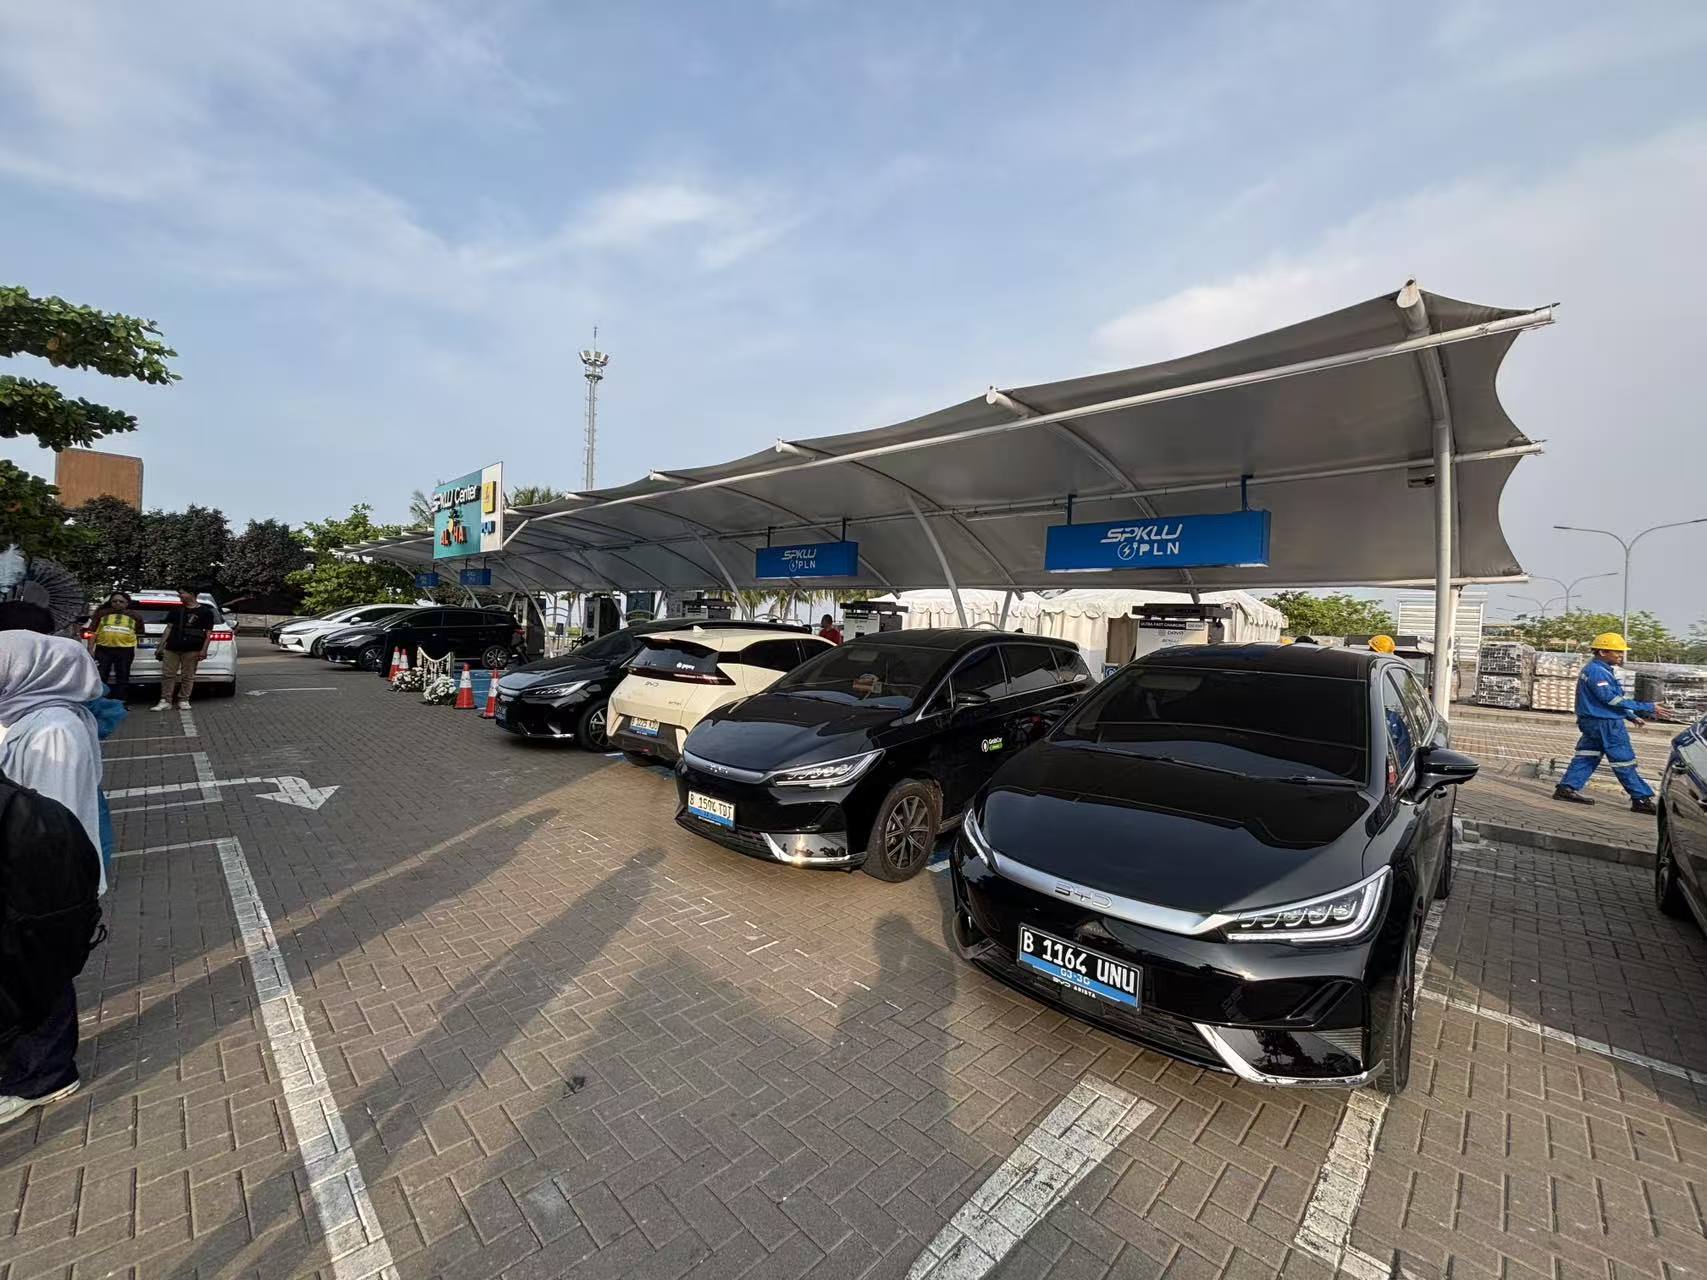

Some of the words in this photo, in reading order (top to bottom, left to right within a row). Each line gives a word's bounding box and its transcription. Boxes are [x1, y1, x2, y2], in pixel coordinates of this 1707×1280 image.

[454, 484, 477, 504] Center
[1100, 523, 1184, 543] SPKLU
[780, 548, 817, 560] SPKLU
[1139, 542, 1181, 556] PLN
[798, 560, 816, 569] PLN
[1054, 880, 1113, 909] BYD
[1023, 931, 1034, 953] B
[1042, 939, 1088, 974] 1164
[1097, 959, 1135, 993] UNU
[1073, 985, 1097, 998] ARISTA
